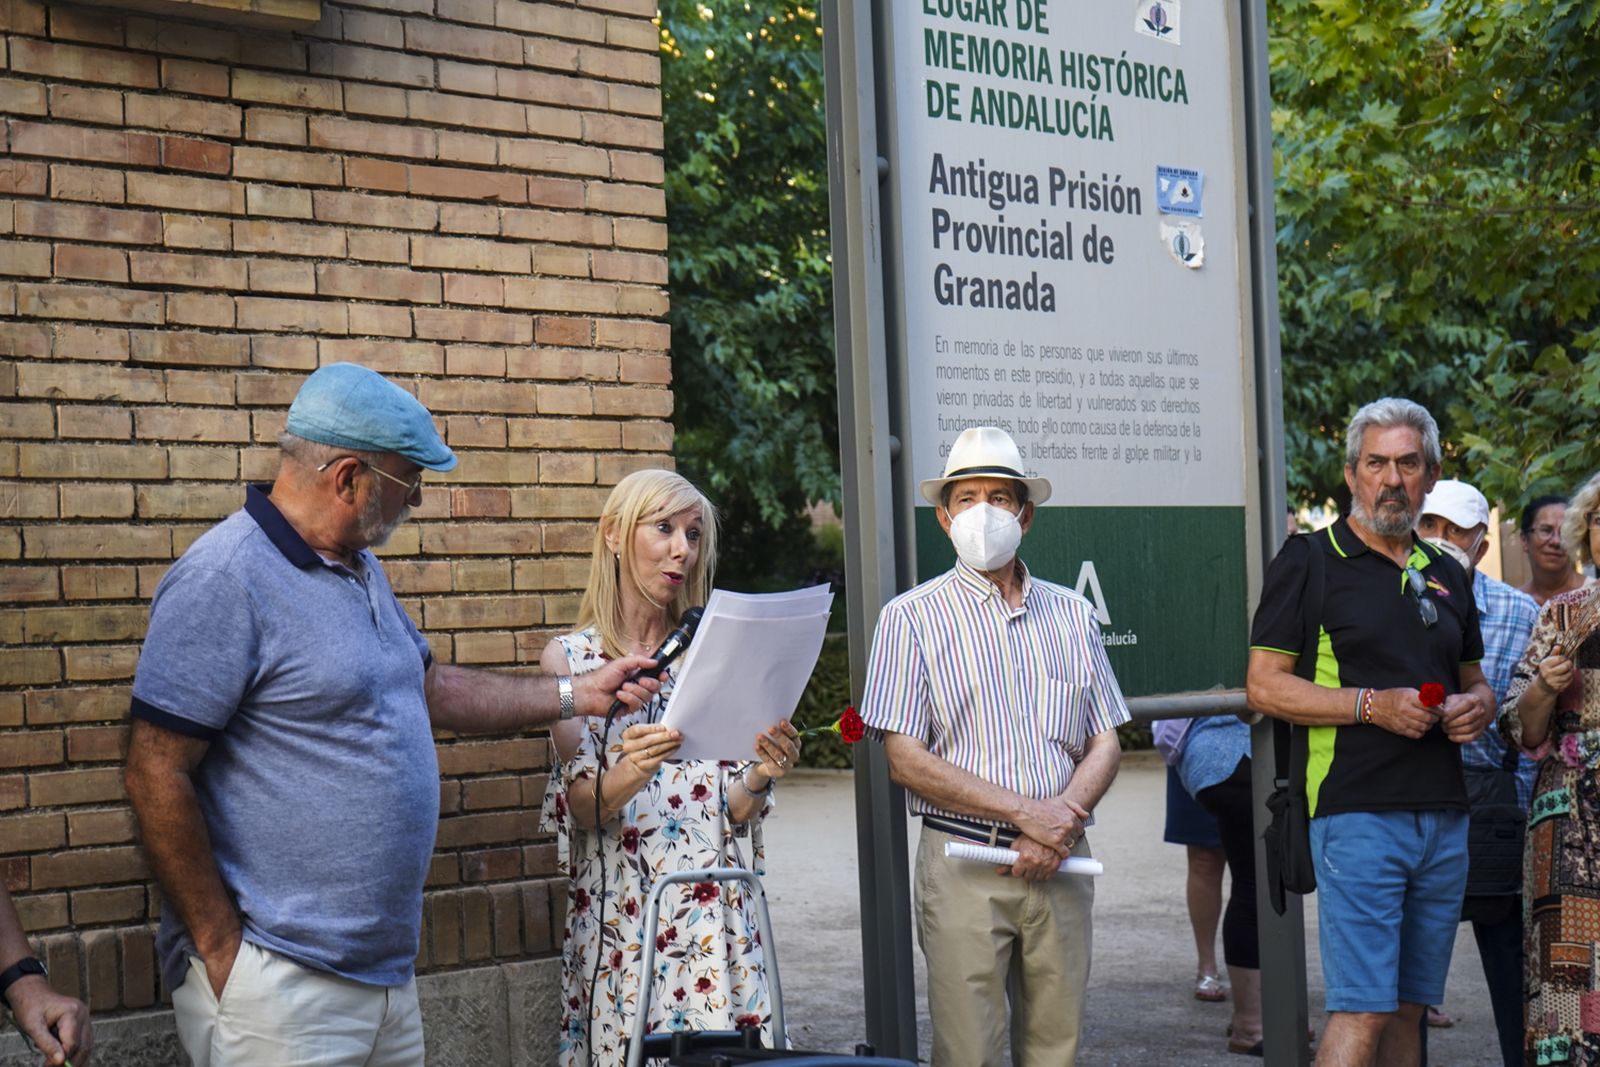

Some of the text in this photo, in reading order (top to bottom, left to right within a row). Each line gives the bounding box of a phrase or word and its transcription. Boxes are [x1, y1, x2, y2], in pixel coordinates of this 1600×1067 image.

[1016, 0, 1049, 35] DE
[924, 27, 1188, 105] MEMORIA HISTÓRICA
[926, 79, 1114, 142] DE ANDALUCÍA
[929, 153, 1142, 215] Antigua Prisión
[932, 207, 1115, 265] Provincial de
[933, 263, 1056, 312] Granada
[935, 335, 1199, 367] En memoria de las personas que vivieron sus últimos
[936, 364, 1200, 392] momentos en este presidio, y a todas aquellas que se
[936, 388, 1200, 415] vieron privadas de libertad y vulnerados sus derechos
[1018, 418, 1040, 435] todo
[1042, 418, 1059, 436] ello
[1061, 421, 1087, 436] como
[1089, 422, 1118, 437] causa
[1119, 420, 1132, 437] de
[1133, 420, 1142, 438] la
[1143, 421, 1179, 438] defensa
[1180, 422, 1192, 439] de
[1193, 422, 1202, 439] la
[1031, 442, 1078, 460] libertades
[1082, 443, 1109, 460] frente
[1112, 445, 1122, 461] al
[1125, 446, 1150, 464] golpe
[1153, 446, 1181, 462] militar
[1184, 449, 1191, 464] y
[1194, 446, 1203, 462] la
[1100, 629, 1138, 646] dalucía
